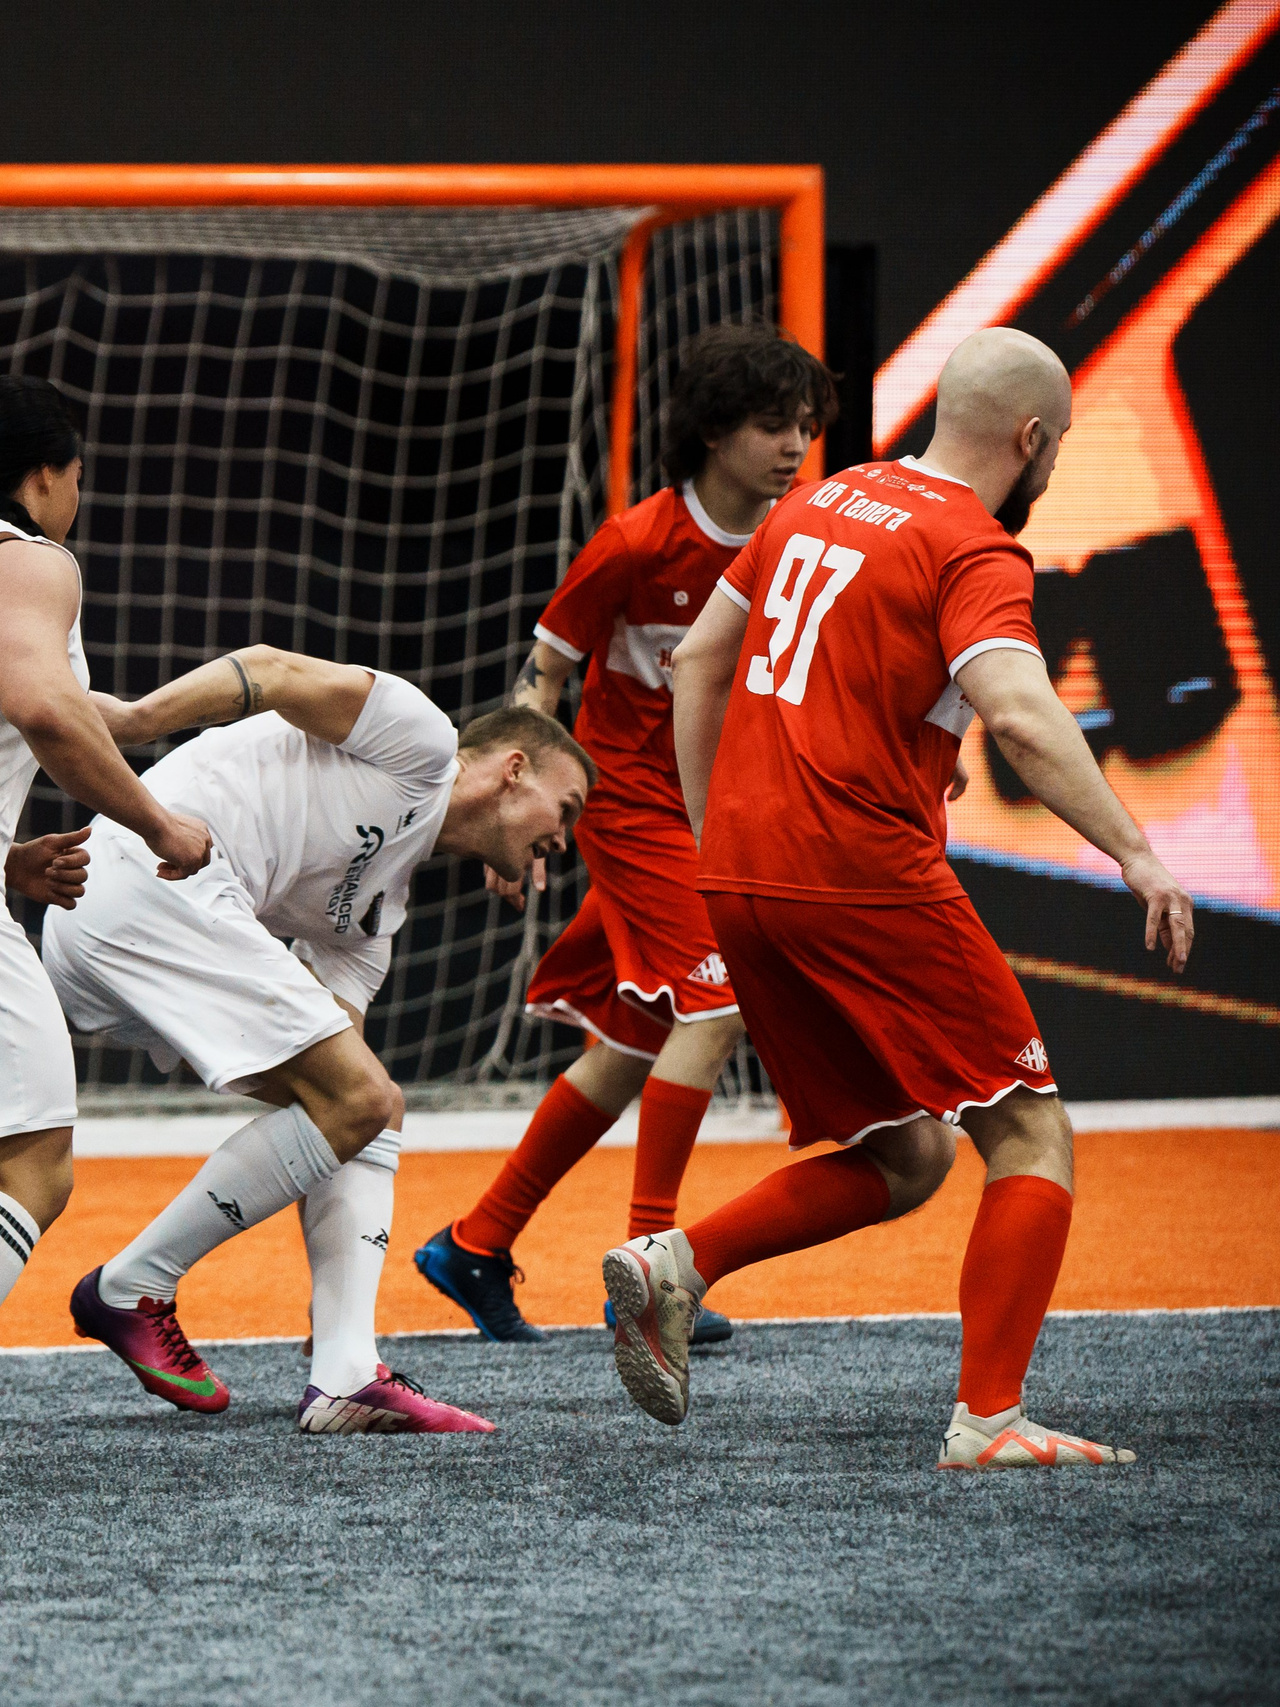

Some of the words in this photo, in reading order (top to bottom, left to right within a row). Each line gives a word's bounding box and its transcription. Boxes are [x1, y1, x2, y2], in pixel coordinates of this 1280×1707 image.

[835, 488, 913, 532] Телега
[745, 533, 866, 706] 97
[300, 1394, 409, 1437] NIKE
